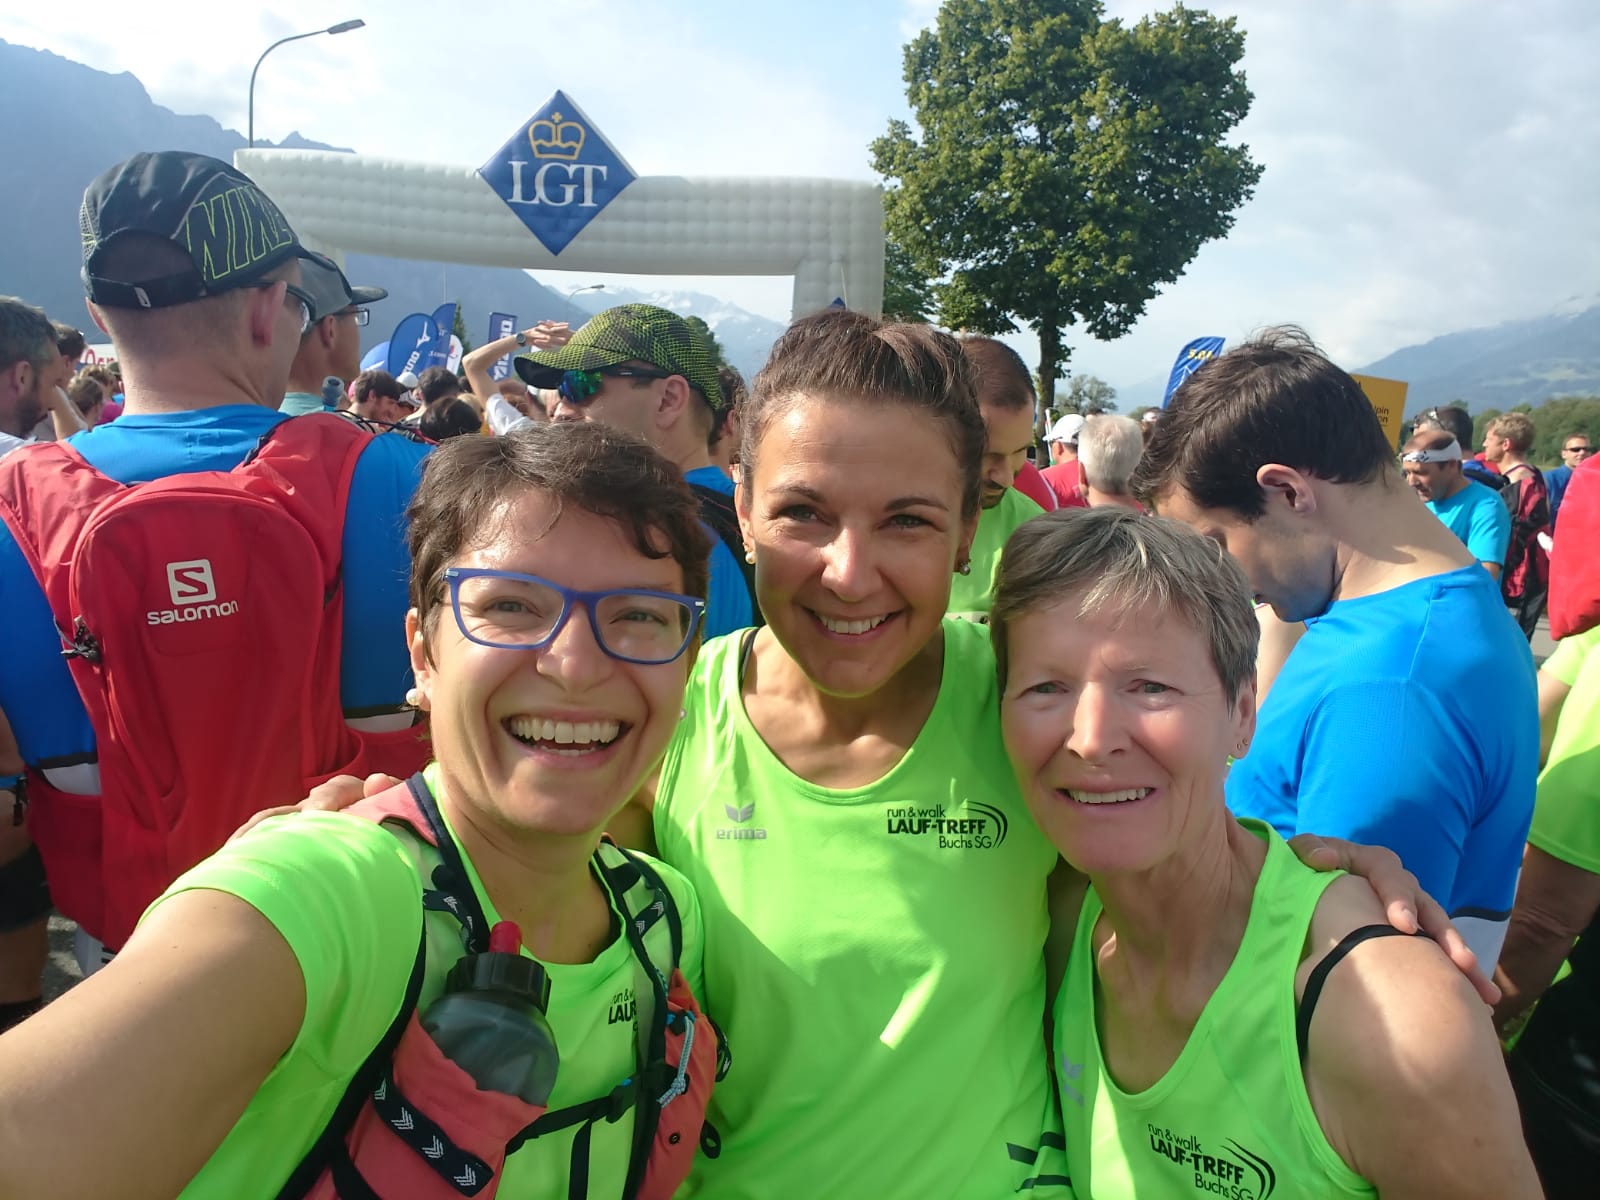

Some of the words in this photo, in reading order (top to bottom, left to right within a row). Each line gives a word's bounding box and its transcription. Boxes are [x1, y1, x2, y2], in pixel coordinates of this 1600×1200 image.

[507, 160, 608, 207] LGT
[887, 808, 906, 818] run
[908, 806, 916, 818] &
[917, 804, 946, 818] walk
[716, 826, 767, 840] erima
[887, 818, 987, 835] LAUF-TREFF
[939, 835, 973, 849] Buchs
[974, 835, 992, 849] SG
[1148, 1123, 1164, 1139] run
[1165, 1128, 1173, 1142] &
[1173, 1135, 1202, 1153] walk
[1150, 1133, 1245, 1185] LAUF-TREFF
[1195, 1172, 1229, 1199] Buchs
[1231, 1185, 1254, 1200] SG
